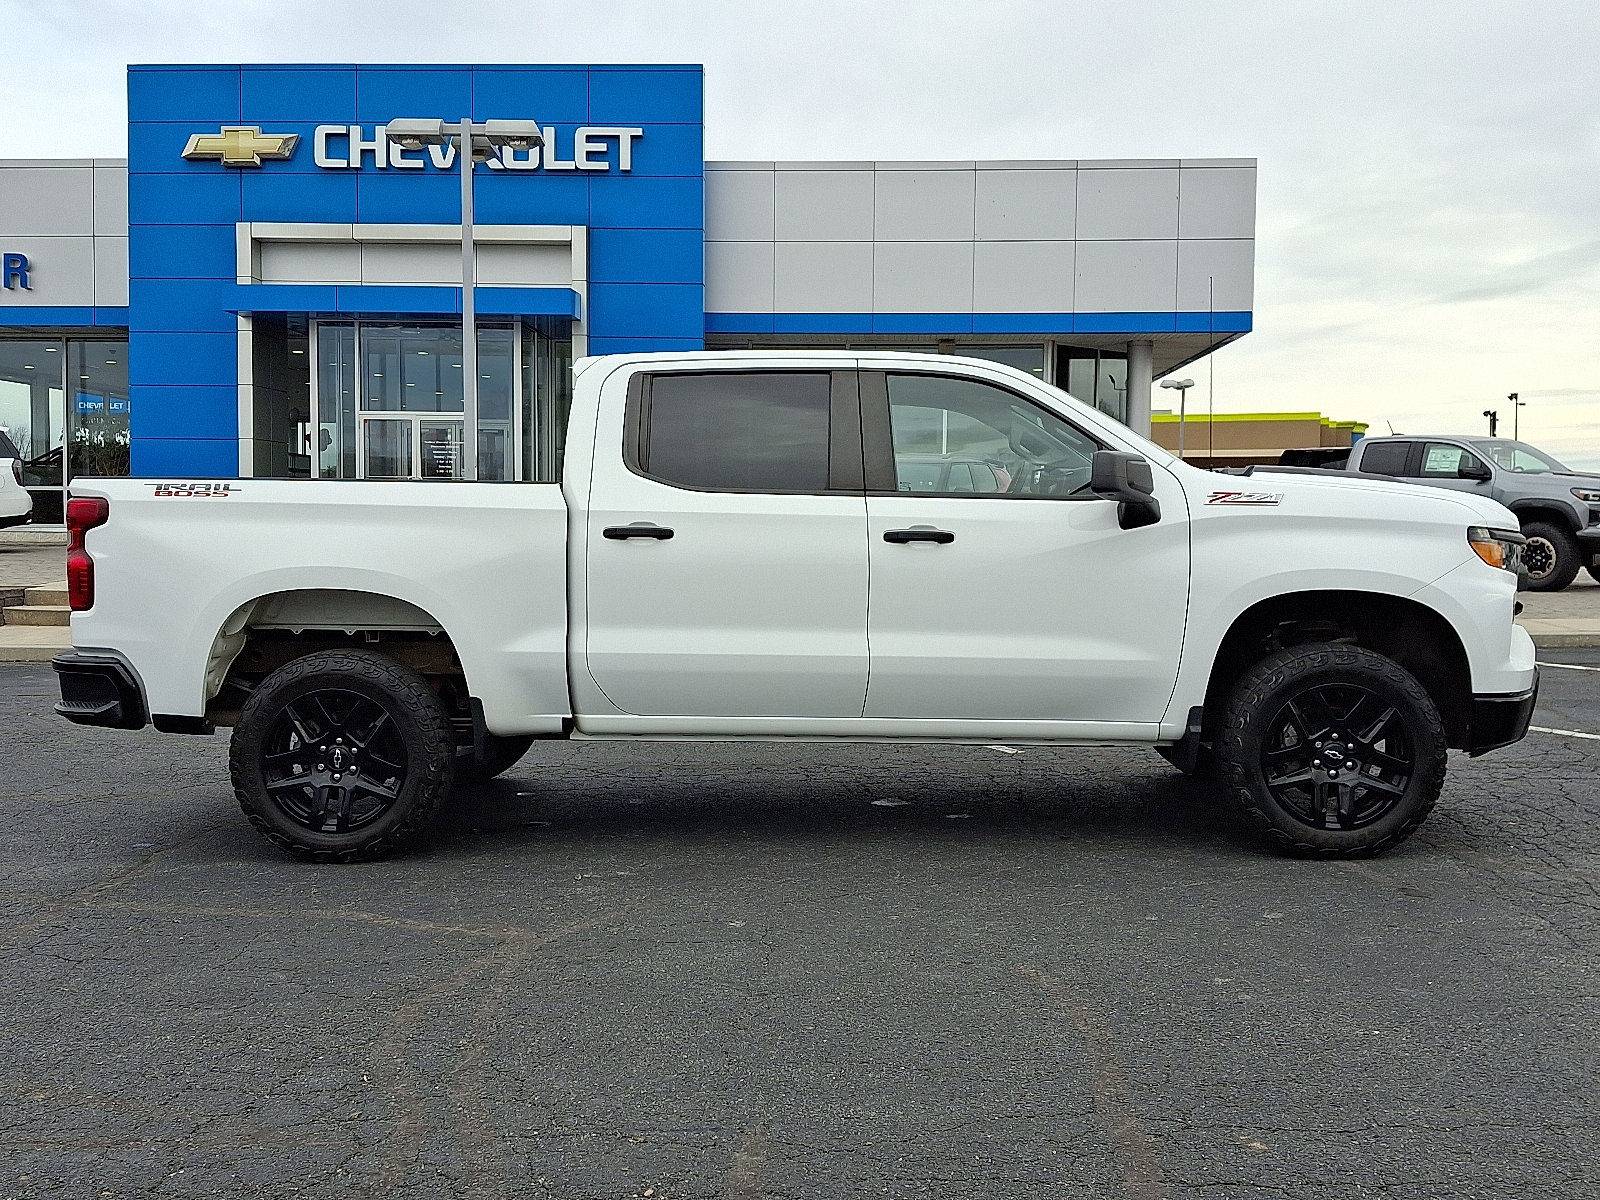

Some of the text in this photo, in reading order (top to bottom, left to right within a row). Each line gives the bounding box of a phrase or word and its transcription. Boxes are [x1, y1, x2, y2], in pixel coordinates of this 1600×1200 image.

[314, 124, 643, 171] CHEVOLET
[144, 483, 242, 492] TRAIL
[1204, 491, 1284, 506] Z71
